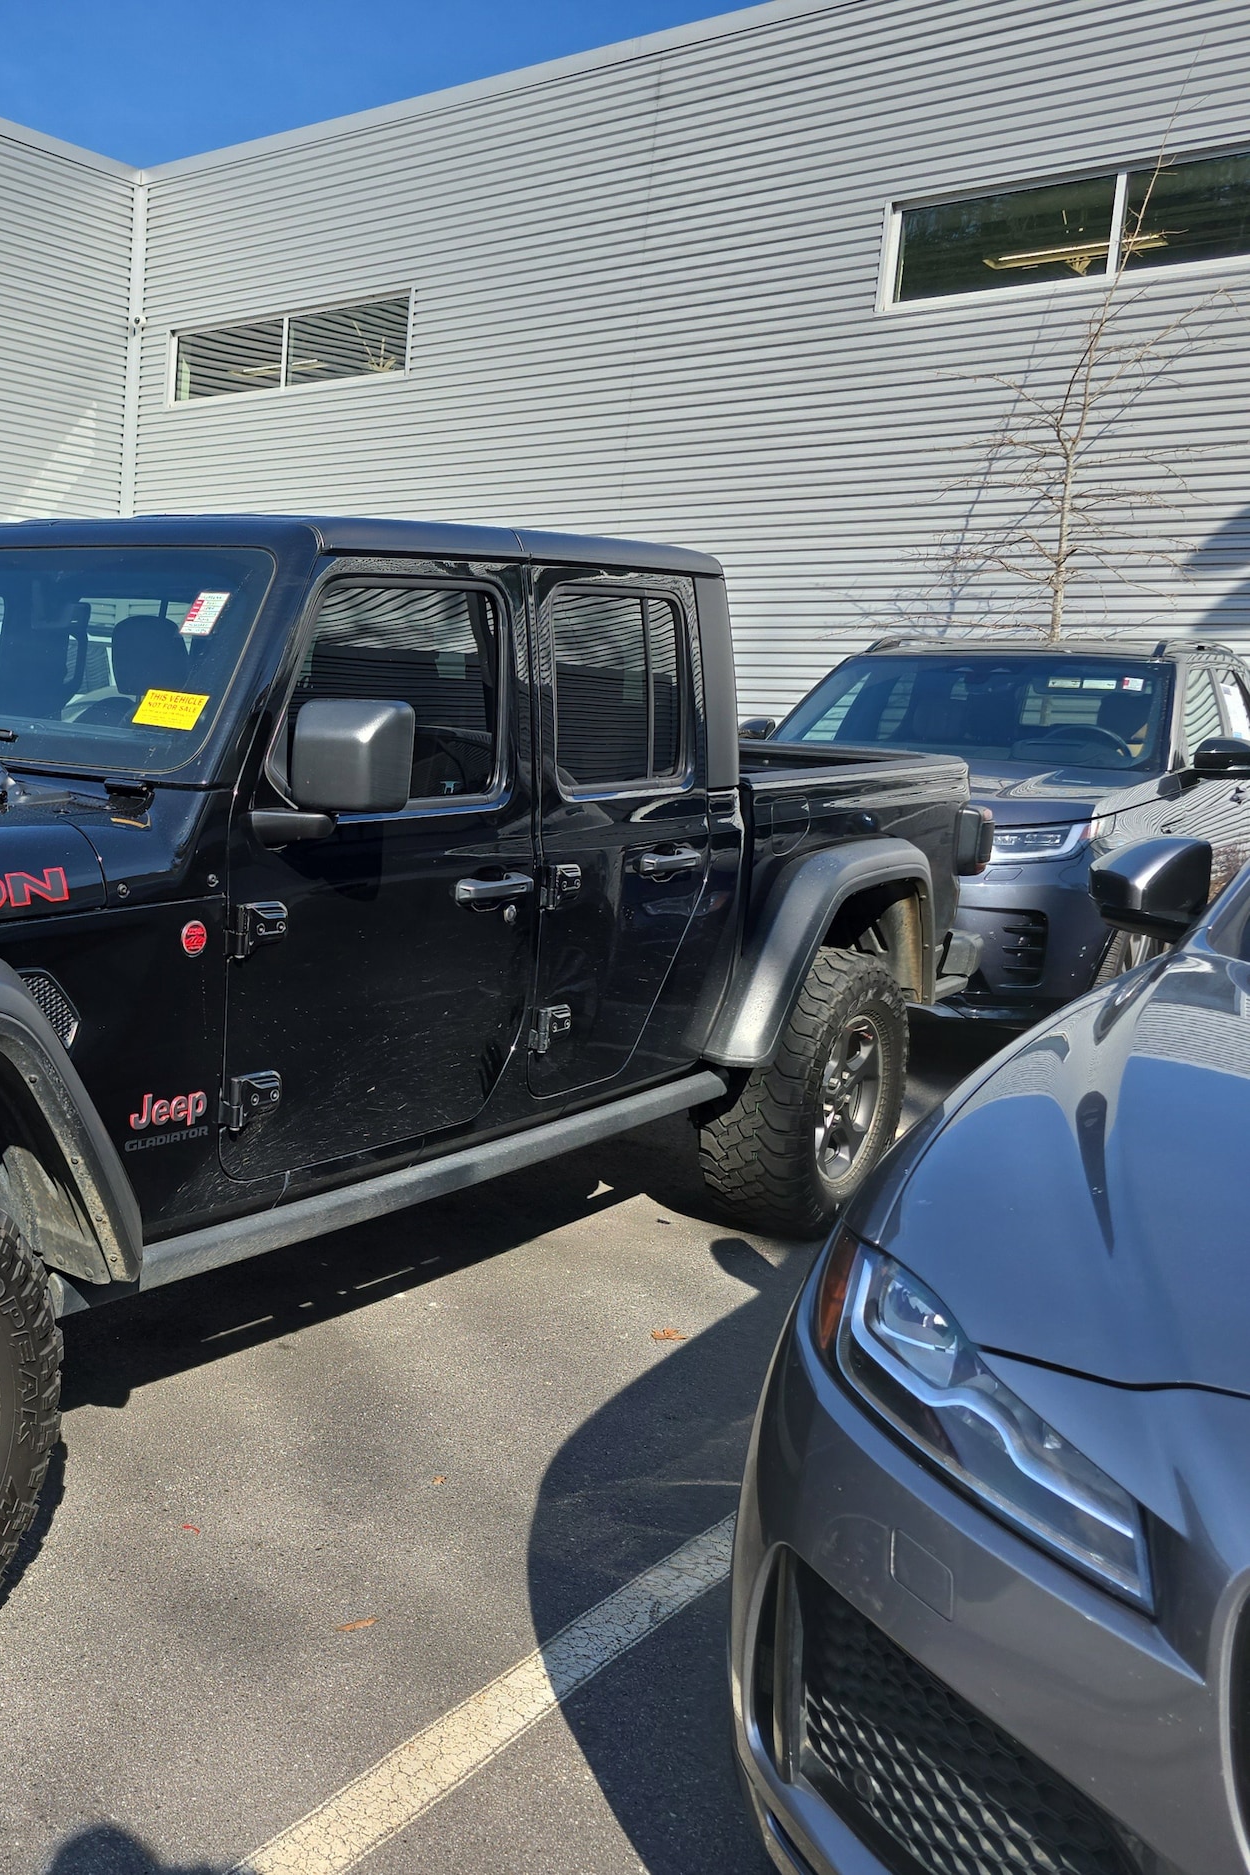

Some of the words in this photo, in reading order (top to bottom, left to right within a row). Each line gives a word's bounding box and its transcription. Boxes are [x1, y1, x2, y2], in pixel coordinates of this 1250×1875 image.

[148, 701, 161, 709] NOT
[162, 703, 178, 711] FOR
[178, 705, 197, 713] SALE
[149, 692, 168, 702] THIS
[169, 695, 204, 706] VEHICLE
[129, 1091, 208, 1130] Jeep
[124, 1125, 209, 1152] GLADIATOR
